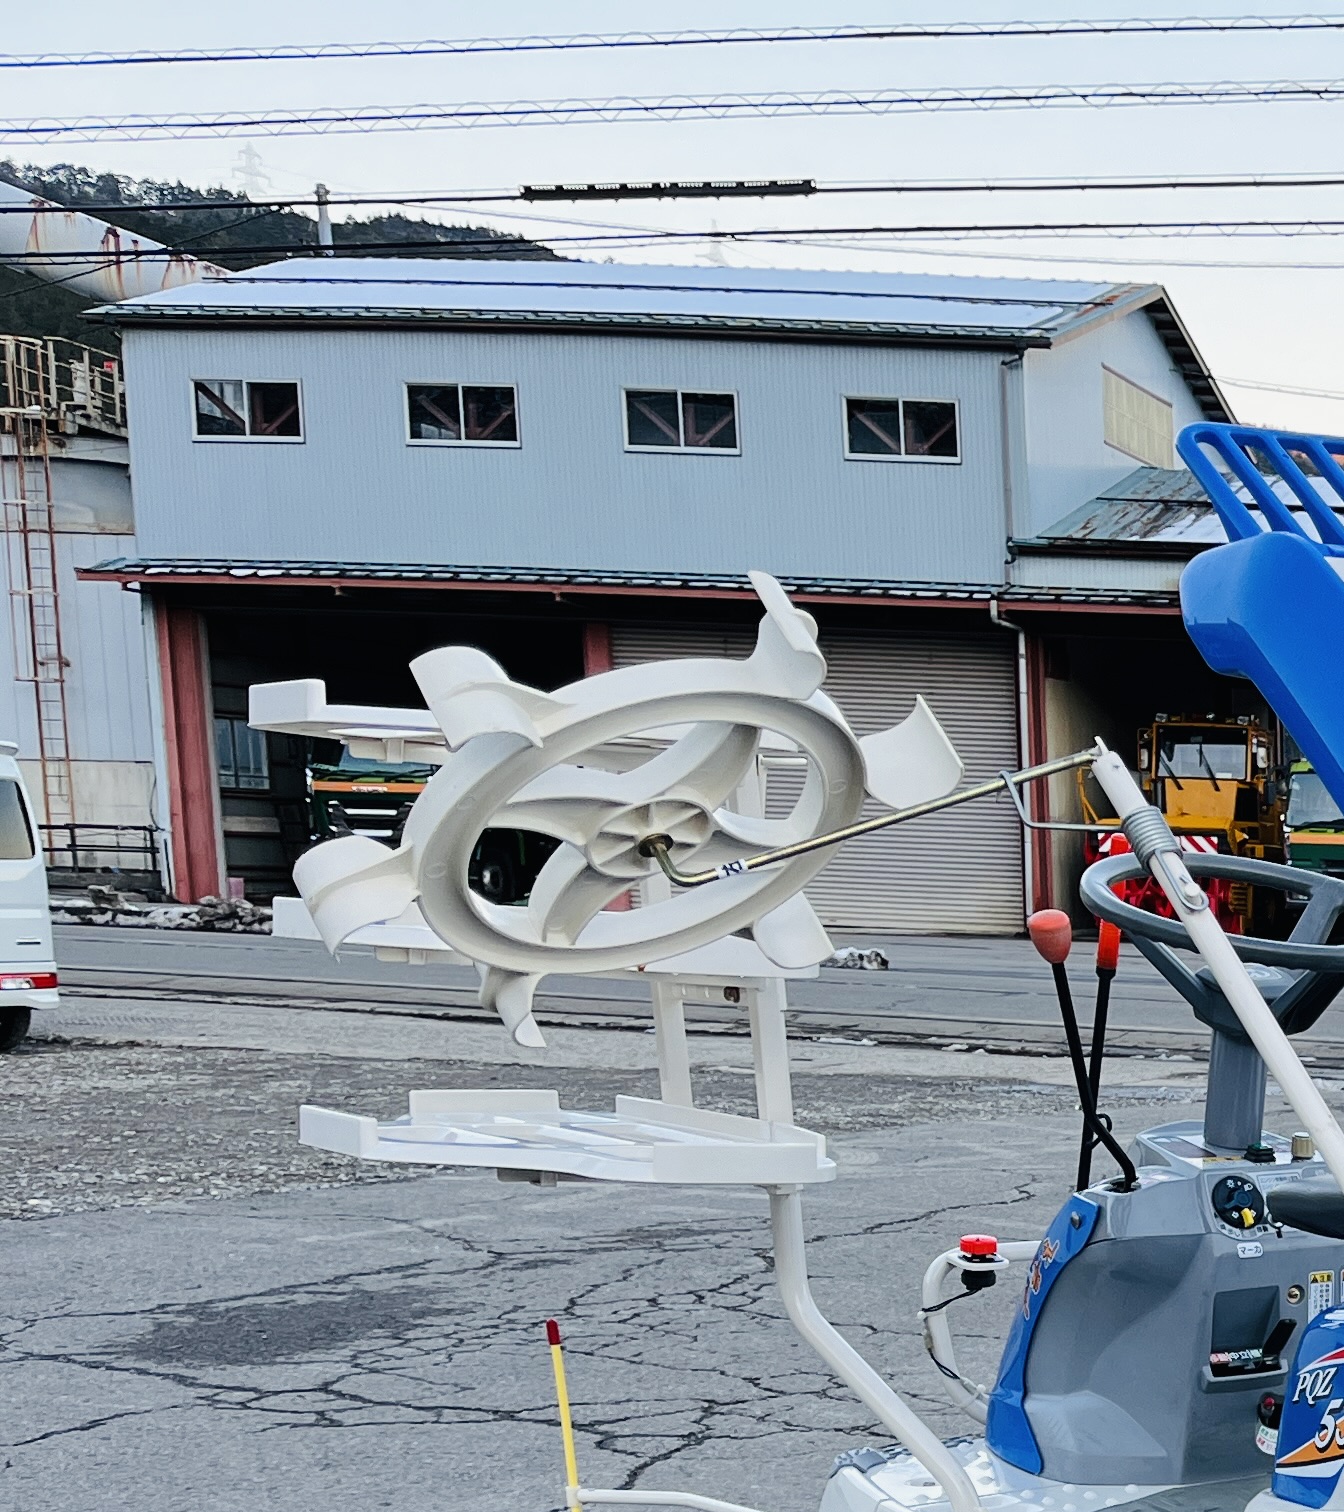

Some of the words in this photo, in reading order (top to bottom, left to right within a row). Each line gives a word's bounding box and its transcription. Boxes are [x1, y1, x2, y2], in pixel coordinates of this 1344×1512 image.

[1238, 1246, 1262, 1255] マーカ
[1292, 1367, 1338, 1406] PQZ
